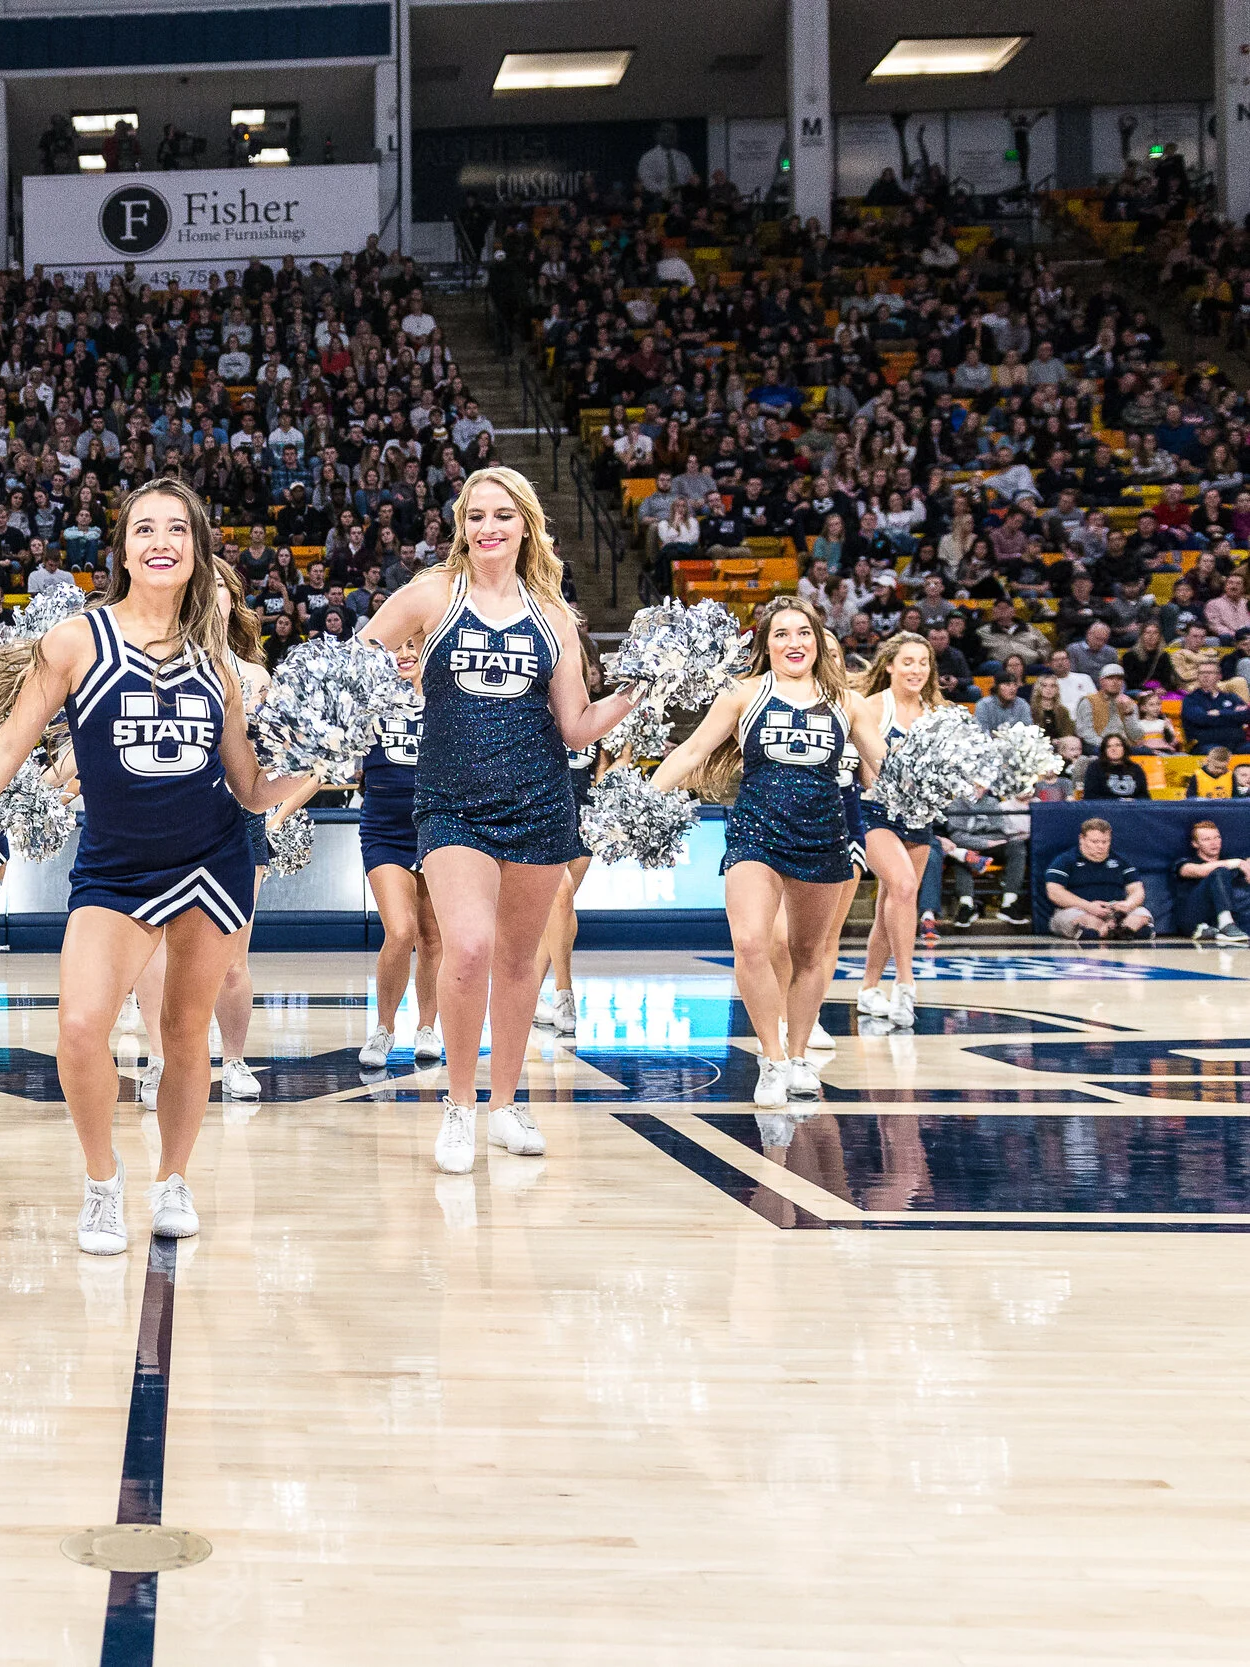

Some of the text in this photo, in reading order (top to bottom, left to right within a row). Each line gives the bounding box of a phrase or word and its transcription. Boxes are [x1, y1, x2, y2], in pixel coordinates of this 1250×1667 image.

[802, 117, 822, 135] M
[119, 200, 150, 241] F
[182, 187, 300, 226] Fisher
[177, 226, 306, 243] Home Furnishings
[450, 650, 539, 679] STATE
[112, 718, 215, 749] STATE
[759, 726, 837, 750] STATE
